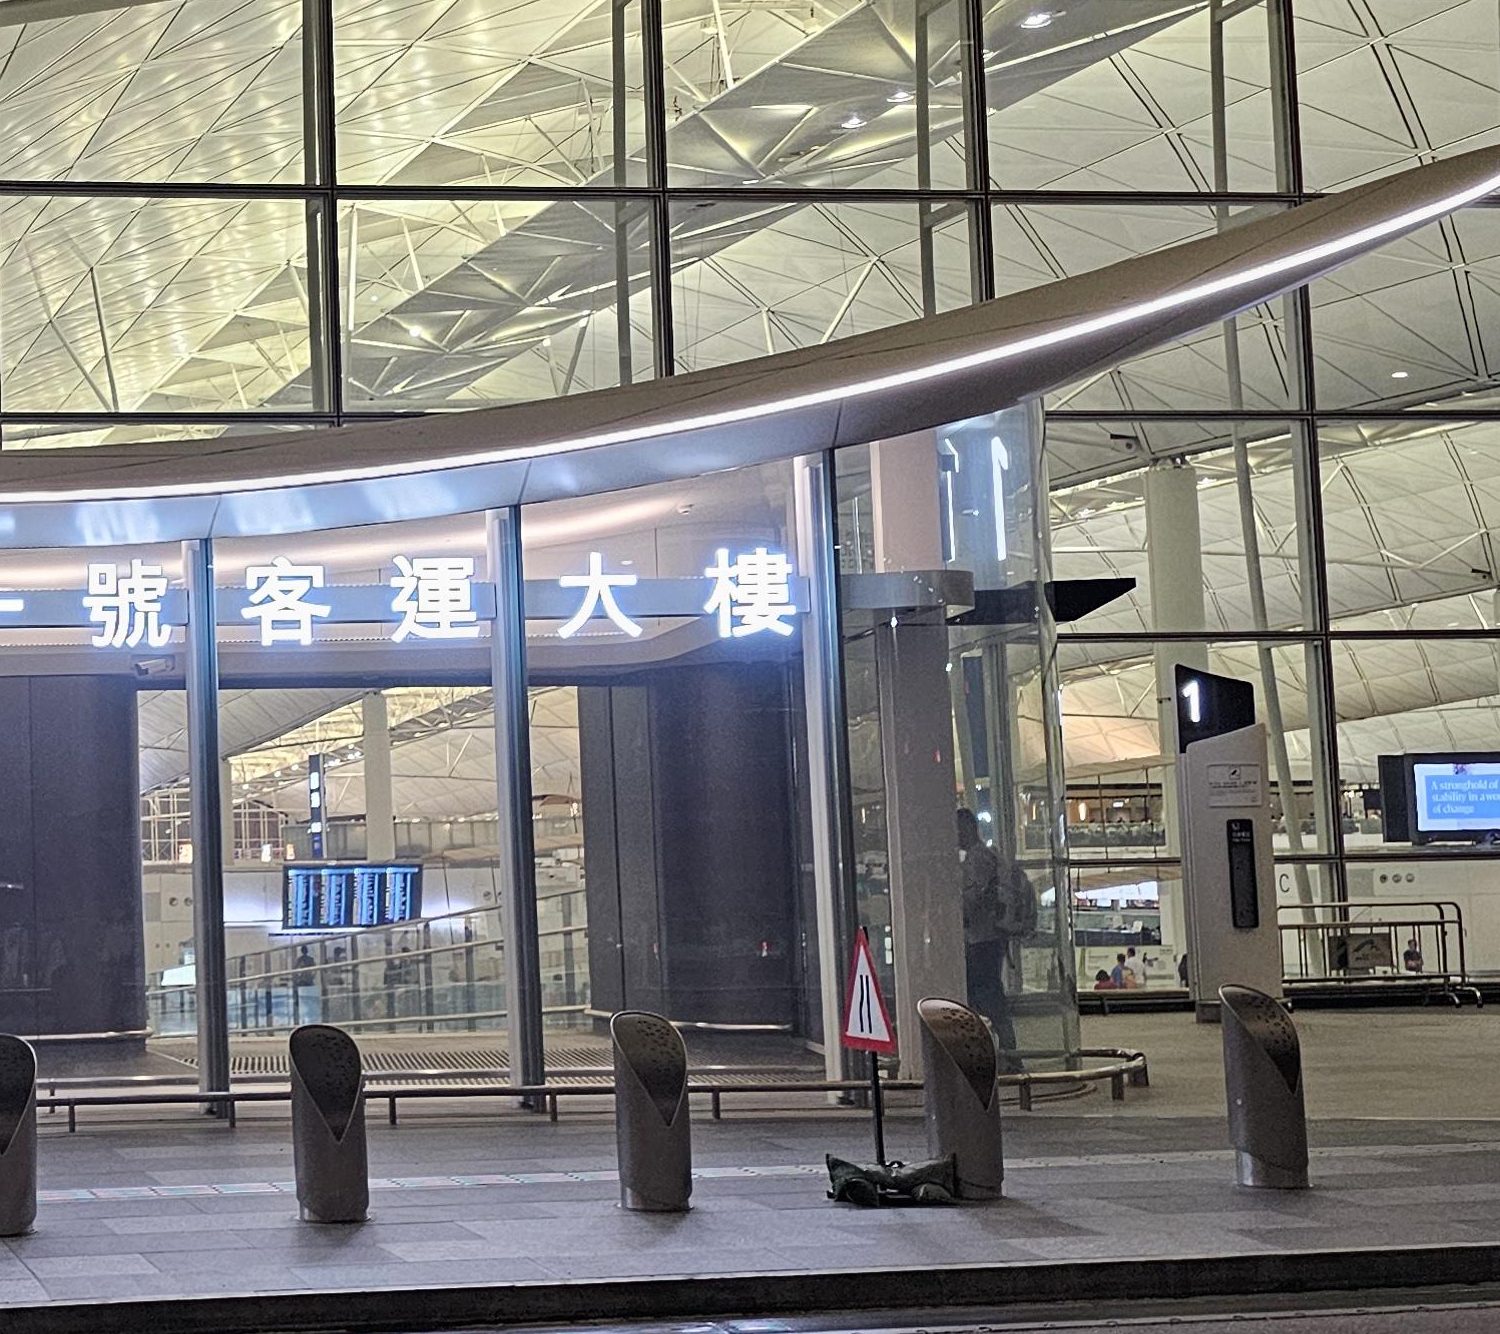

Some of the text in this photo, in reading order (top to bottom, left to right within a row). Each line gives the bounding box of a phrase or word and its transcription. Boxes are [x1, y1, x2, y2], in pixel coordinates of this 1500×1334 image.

[1182, 680, 1201, 723] 1
[1431, 780, 1438, 790] A
[1431, 791, 1467, 803] stability
